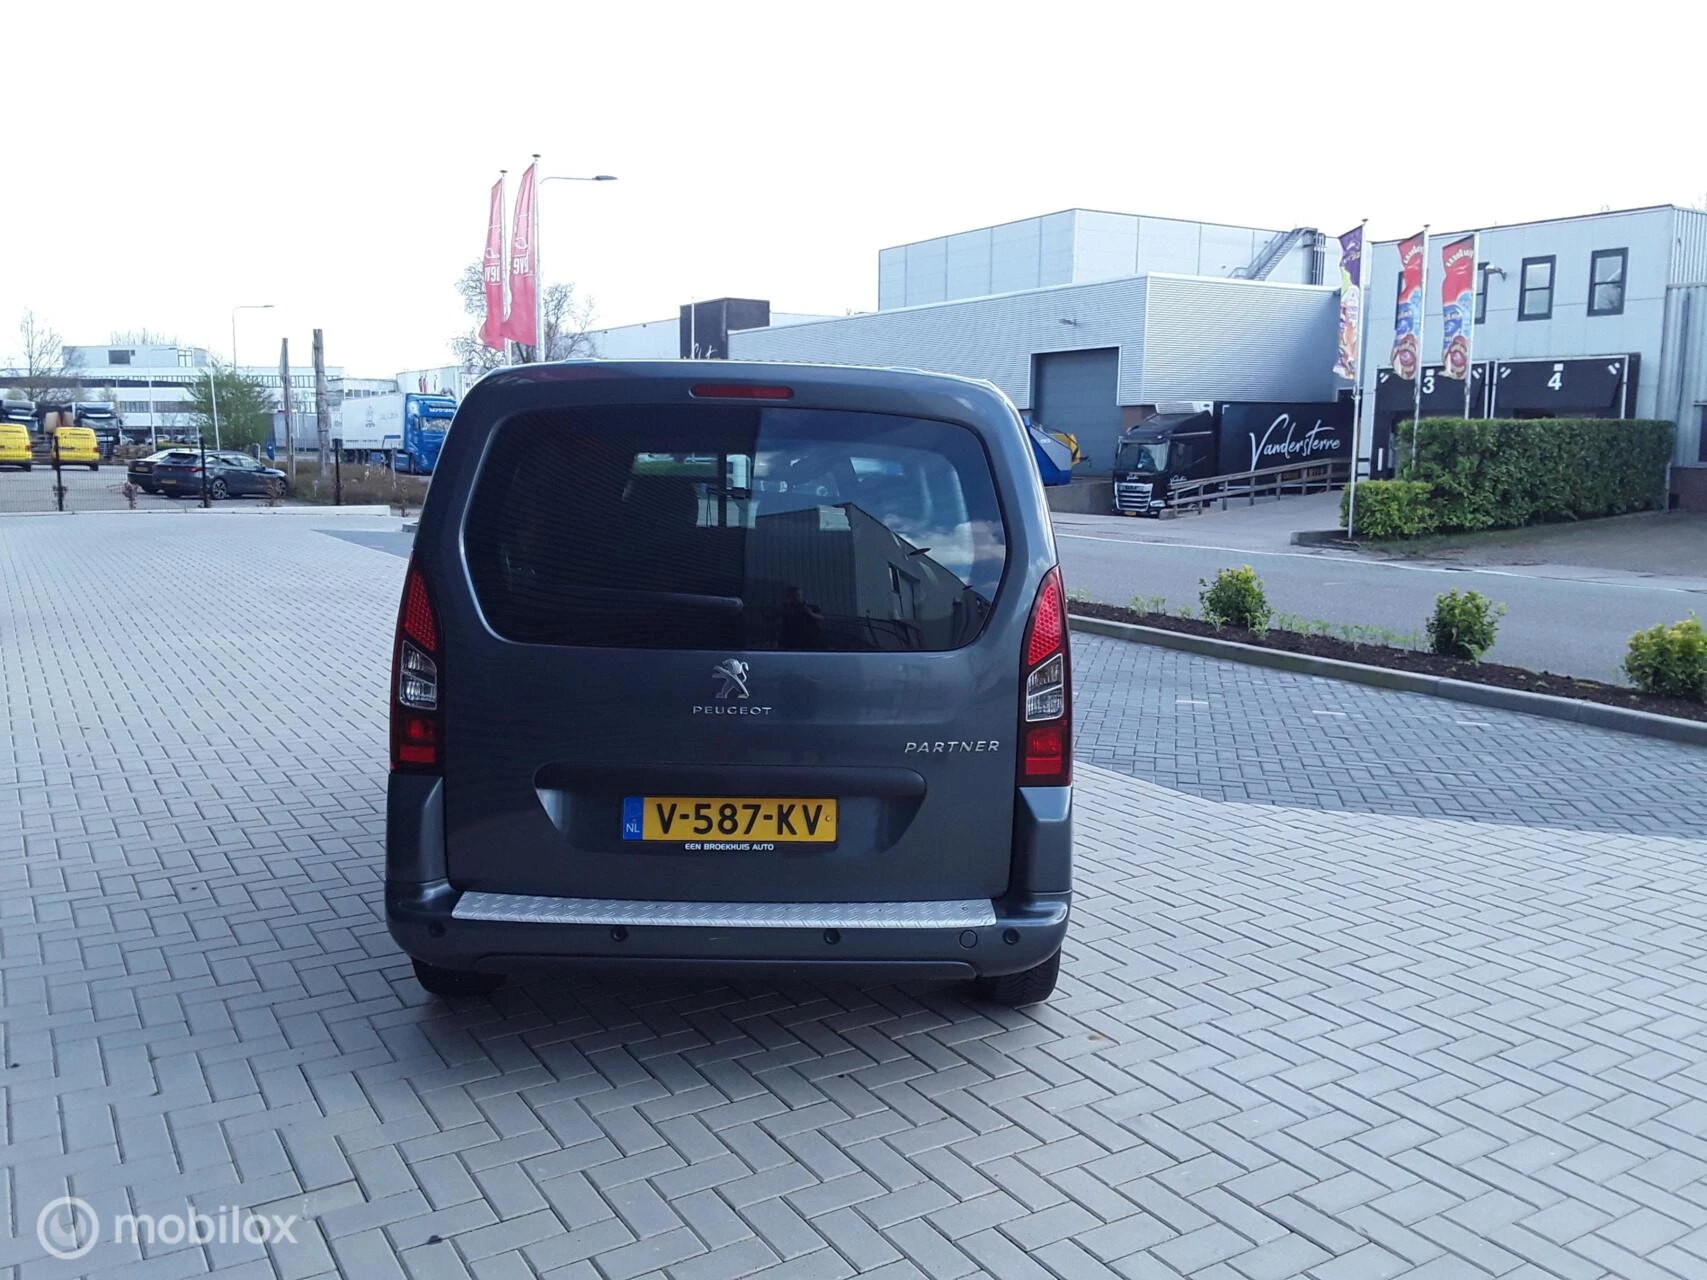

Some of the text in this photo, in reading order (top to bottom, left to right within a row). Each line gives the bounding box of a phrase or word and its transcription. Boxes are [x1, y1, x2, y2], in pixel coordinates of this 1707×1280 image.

[1422, 377, 1435, 394] 3
[1547, 373, 1562, 390] 4
[1249, 413, 1341, 471] Vandersterre
[692, 705, 772, 716] PEUGEOT
[904, 740, 1000, 753] PARTNER
[656, 803, 823, 835] V-587-KV
[626, 822, 640, 833] NL
[685, 843, 774, 851] EEN BROEKHUIS AUTO
